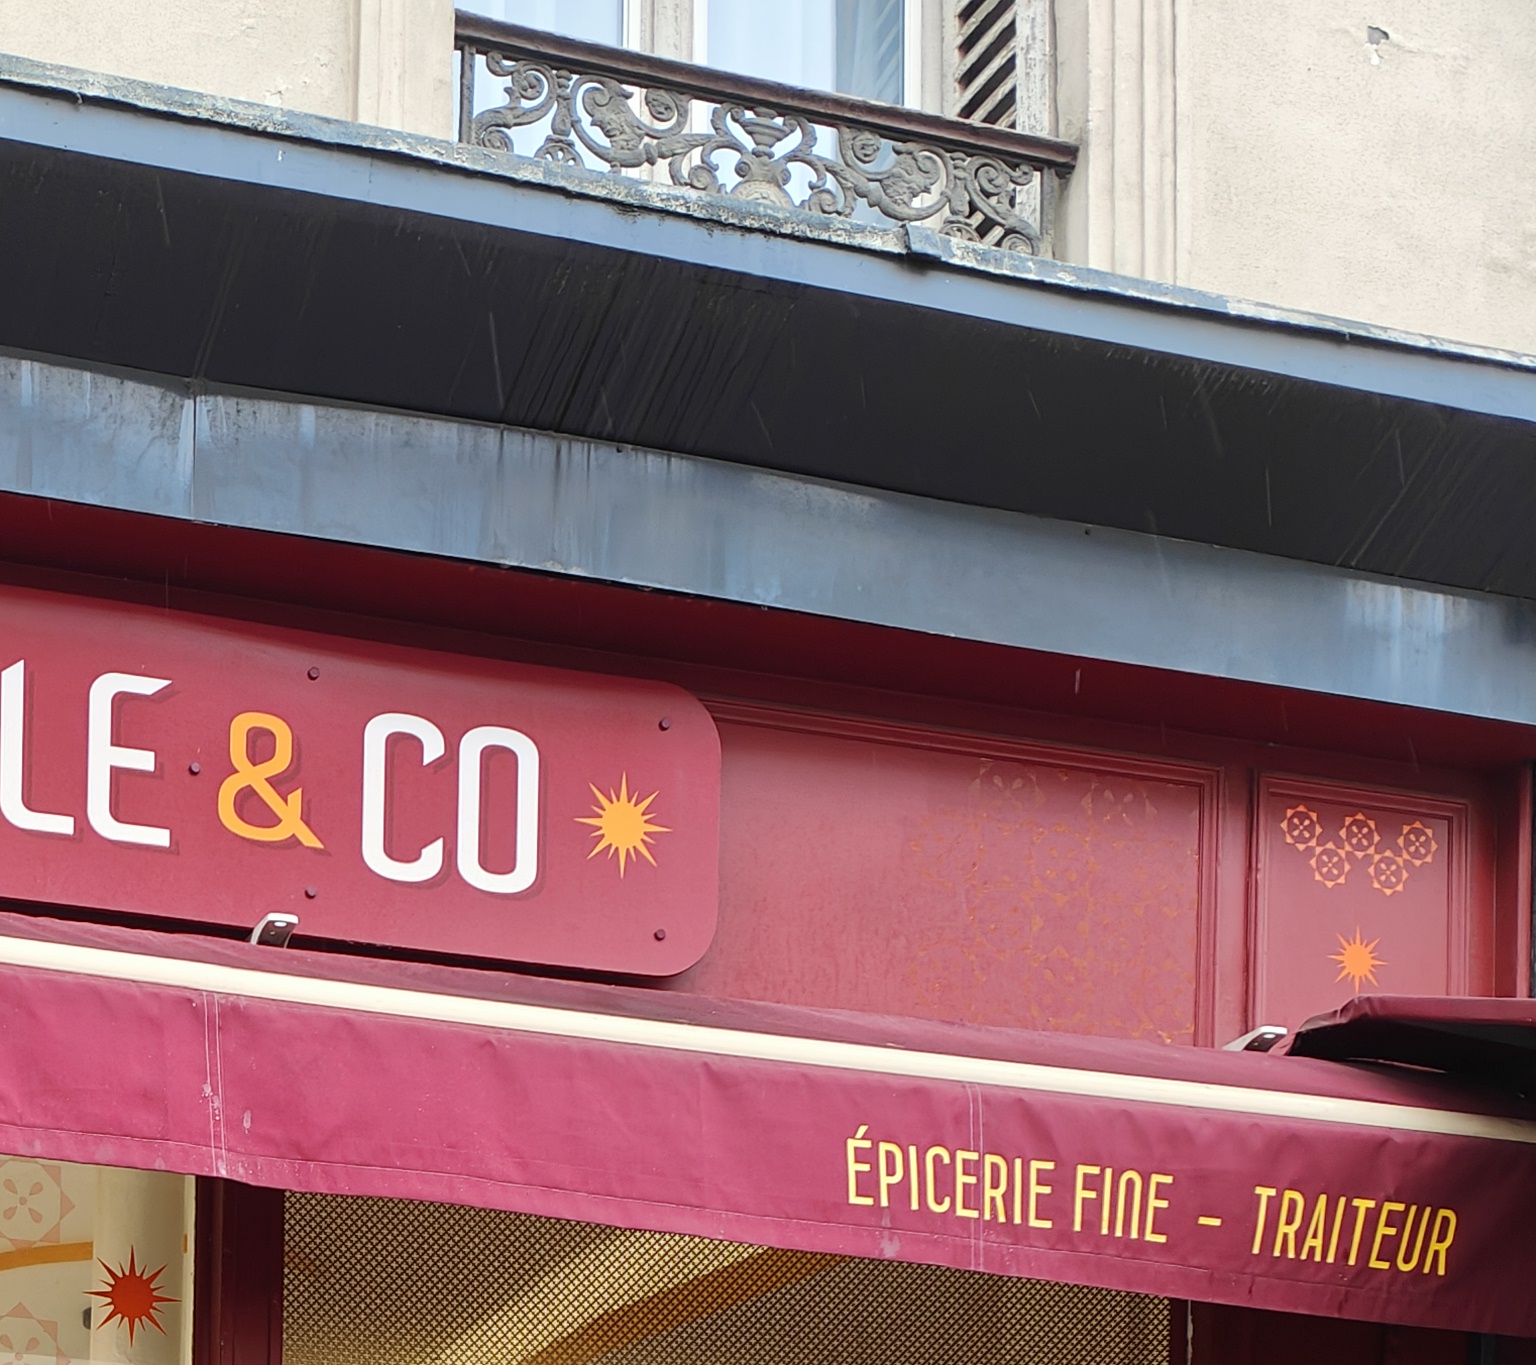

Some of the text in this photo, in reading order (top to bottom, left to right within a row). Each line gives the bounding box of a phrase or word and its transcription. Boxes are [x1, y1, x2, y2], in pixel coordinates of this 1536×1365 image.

[216, 710, 325, 849] &
[361, 711, 541, 896] CO
[846, 1124, 1055, 1230] ÉPICERIE
[1072, 1163, 1174, 1244] FINE
[1251, 1184, 1458, 1277] TRAITEUR
